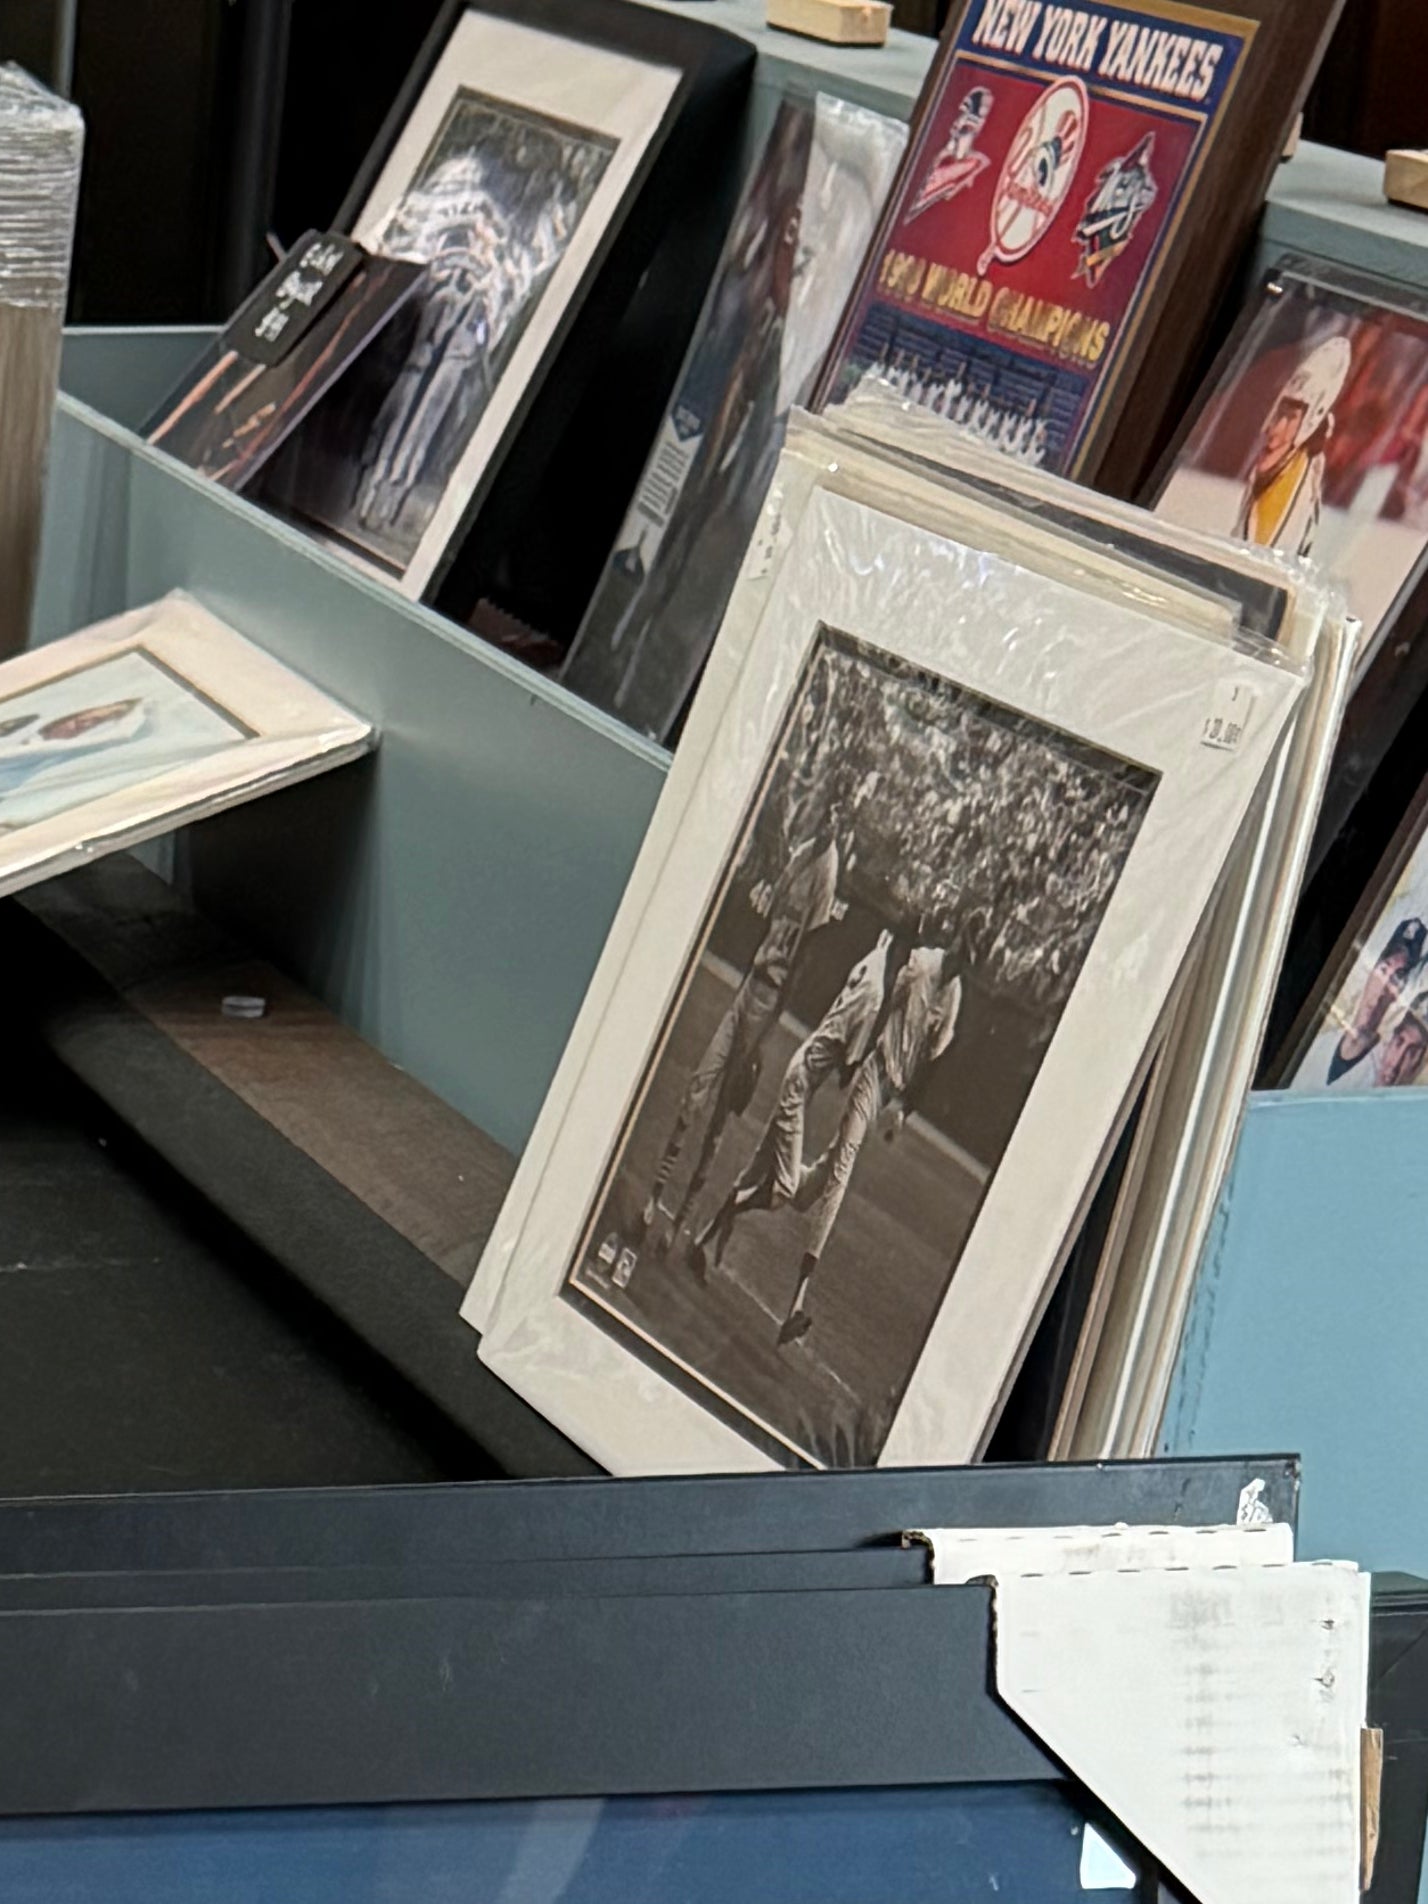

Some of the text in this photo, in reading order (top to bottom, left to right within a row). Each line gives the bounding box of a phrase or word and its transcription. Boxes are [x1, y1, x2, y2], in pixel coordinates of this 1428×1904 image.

[971, 0, 1224, 101] NEW YORK YANKEES
[921, 262, 994, 318] WORLD
[988, 286, 1111, 361] CHAMPIONS
